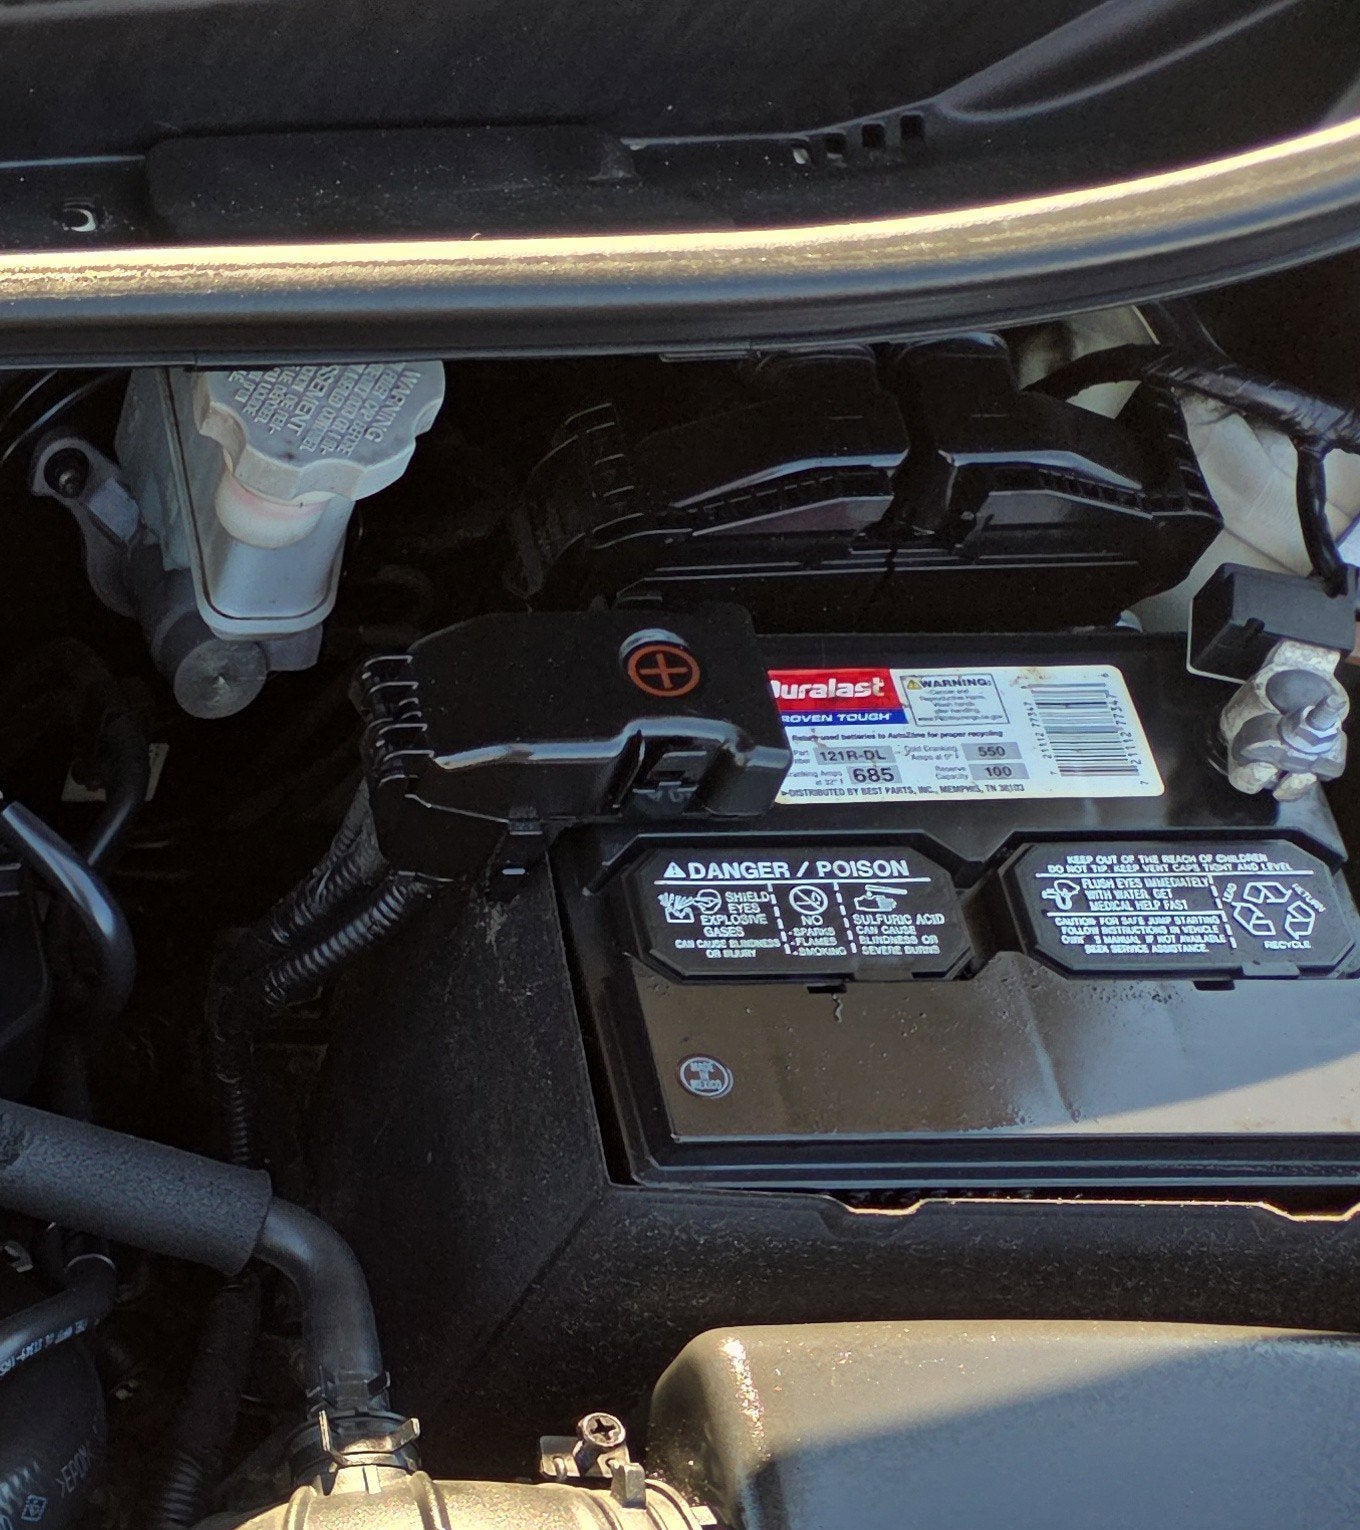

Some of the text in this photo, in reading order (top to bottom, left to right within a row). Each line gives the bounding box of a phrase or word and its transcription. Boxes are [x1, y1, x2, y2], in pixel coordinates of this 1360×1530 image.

[364, 370, 421, 443] WARNING
[782, 712, 890, 723] ROVEN TOUGH
[819, 749, 887, 762] 121R-DL
[977, 745, 1006, 758] 550
[852, 767, 895, 783] 685
[985, 766, 1013, 778] 100
[1095, 855, 1117, 864] OUT
[687, 862, 790, 879] DANGER
[816, 860, 910, 877] POISON
[1081, 876, 1209, 889] FLUSH EYES IMMEDIATELY
[724, 891, 770, 903] SHIELD
[1084, 889, 1112, 900] WITH
[1152, 888, 1172, 899] GET
[728, 903, 761, 914] EYES
[1089, 899, 1188, 911] MEDICAL HELP FAST
[700, 914, 768, 926] EXPLOSIVE
[800, 915, 824, 926] NO
[852, 913, 945, 925] SULFURIC ACID
[703, 926, 745, 937] GASES
[855, 925, 917, 935] CAN CAUSE
